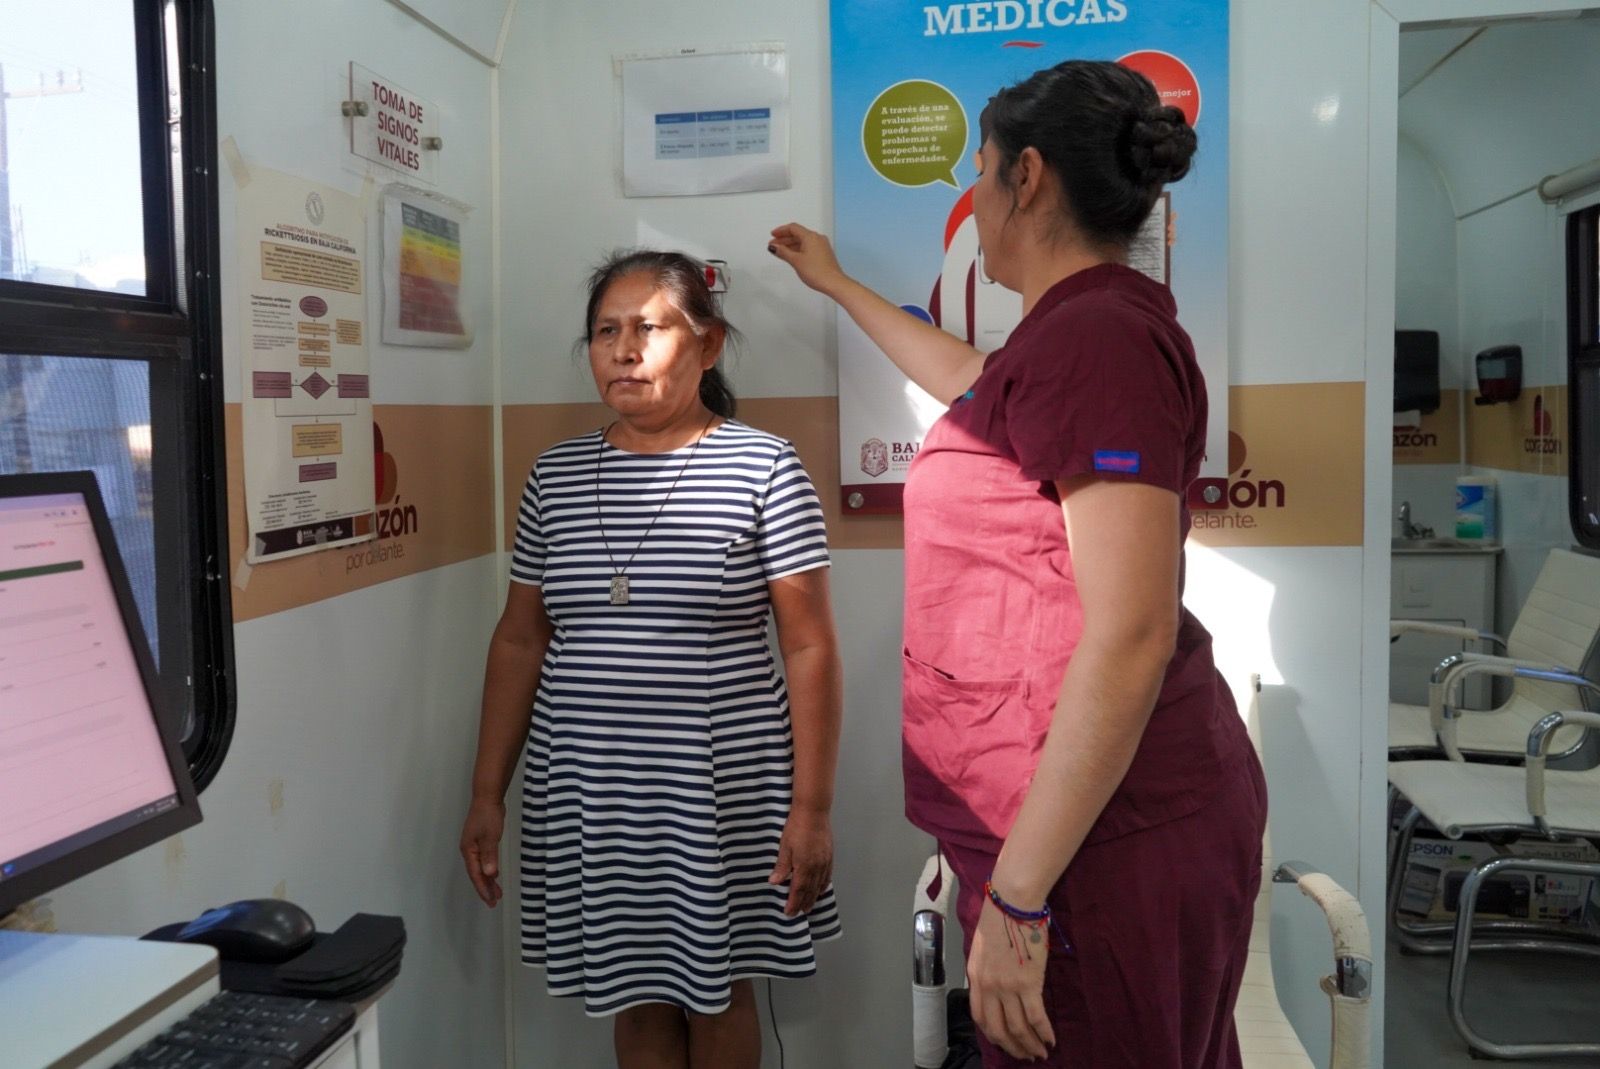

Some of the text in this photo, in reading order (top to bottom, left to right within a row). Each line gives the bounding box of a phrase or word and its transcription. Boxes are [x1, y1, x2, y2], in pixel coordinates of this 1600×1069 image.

[1162, 89, 1192, 99] mejor
[372, 81, 423, 124] TOMA DE
[881, 104, 949, 115] A través de una
[881, 115, 933, 125] evaluación,
[378, 111, 419, 146] SIGNOS
[881, 125, 948, 137] puede detectar
[881, 136, 929, 147] problemas
[377, 136, 419, 170] VITALES
[881, 146, 928, 156] sospechas
[881, 155, 949, 165] enfermedades.
[892, 442, 920, 454] BAJ
[1229, 469, 1285, 508] ón
